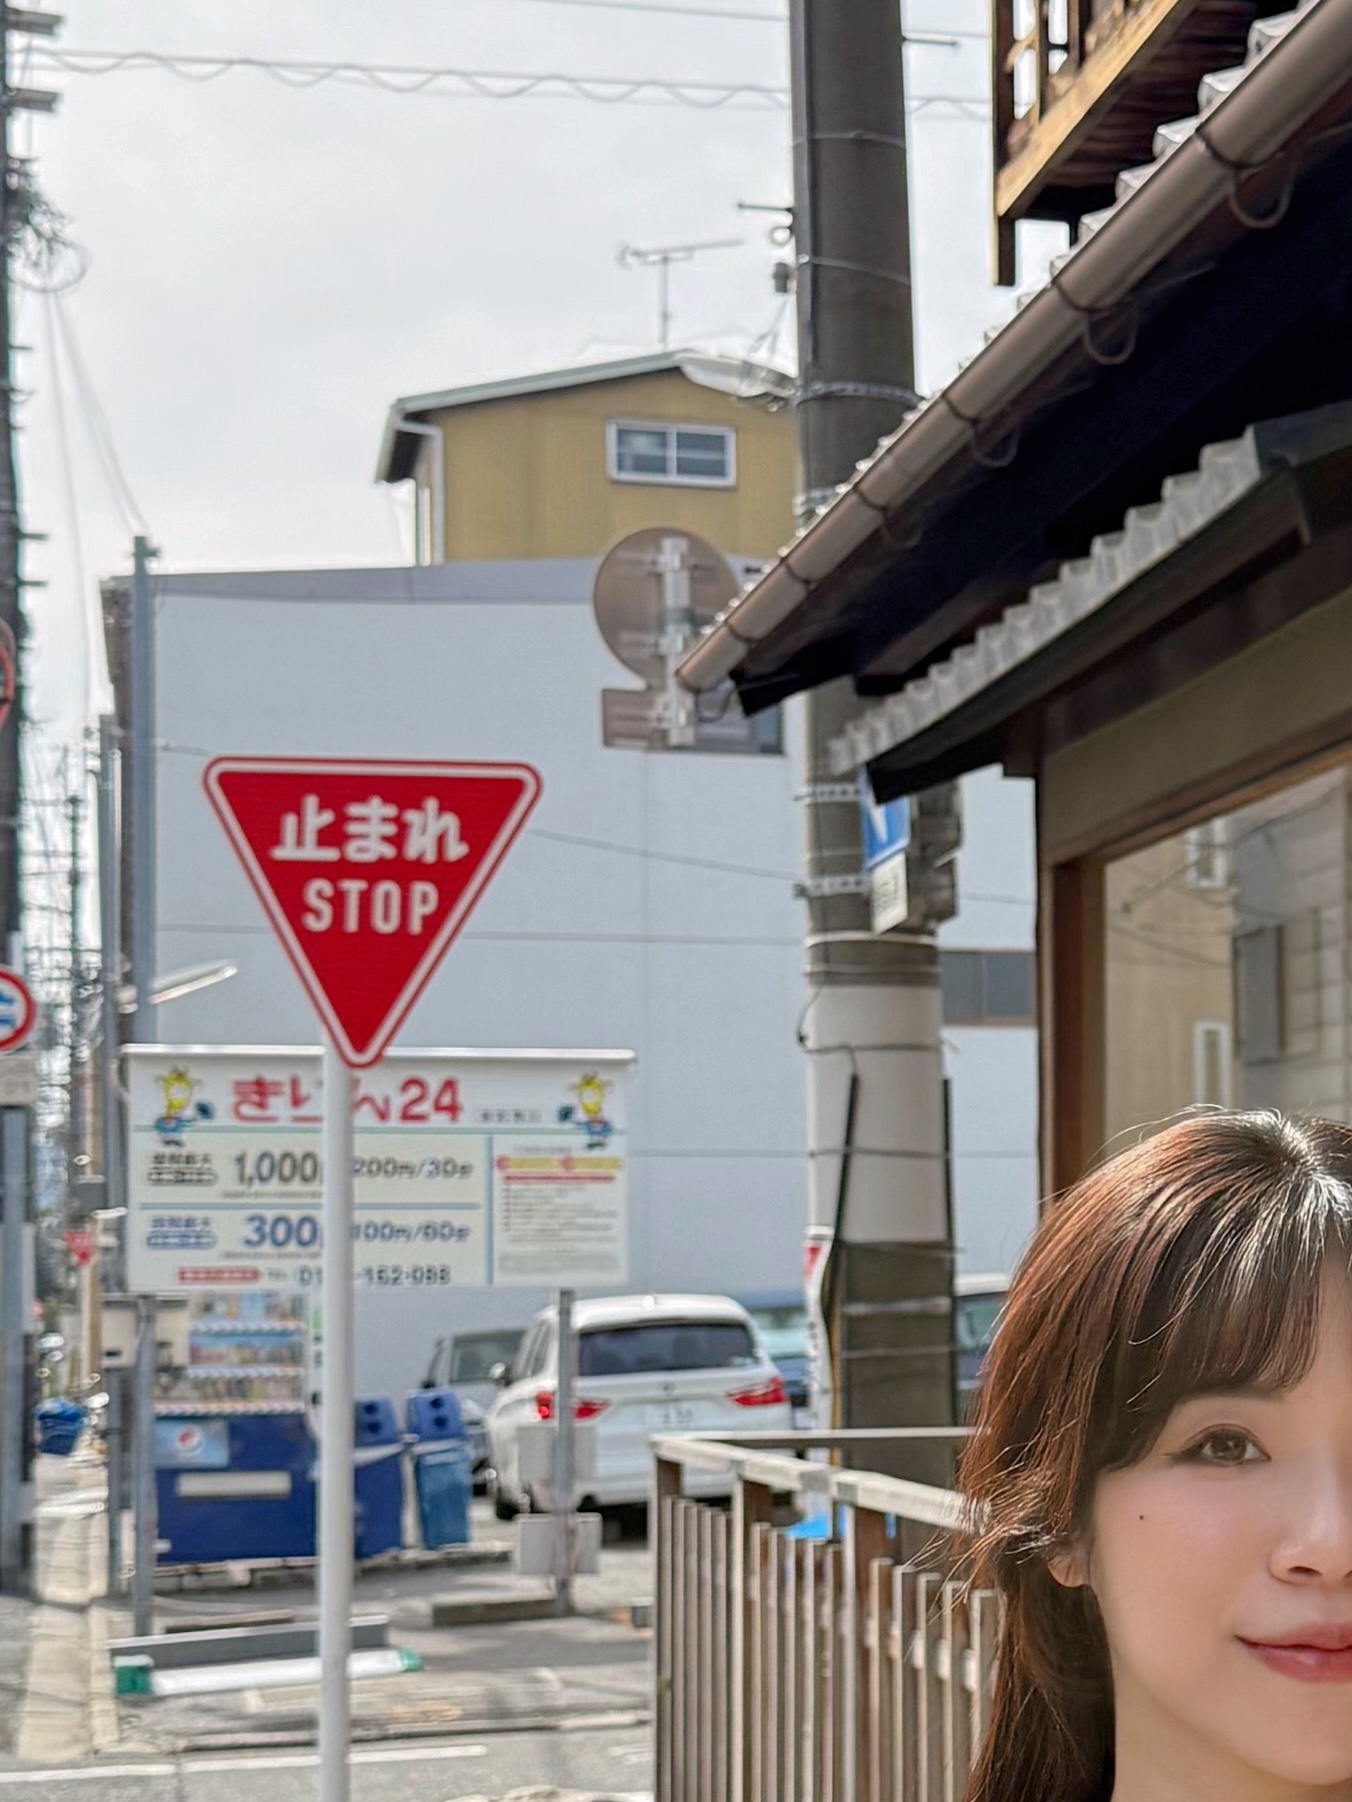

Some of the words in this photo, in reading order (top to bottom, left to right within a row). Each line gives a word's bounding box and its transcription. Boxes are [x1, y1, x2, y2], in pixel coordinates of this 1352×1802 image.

[270, 794, 470, 864] 止まれ
[302, 878, 439, 936] STOP
[233, 1151, 322, 1188] 1,000
[243, 1214, 322, 1248] 300
